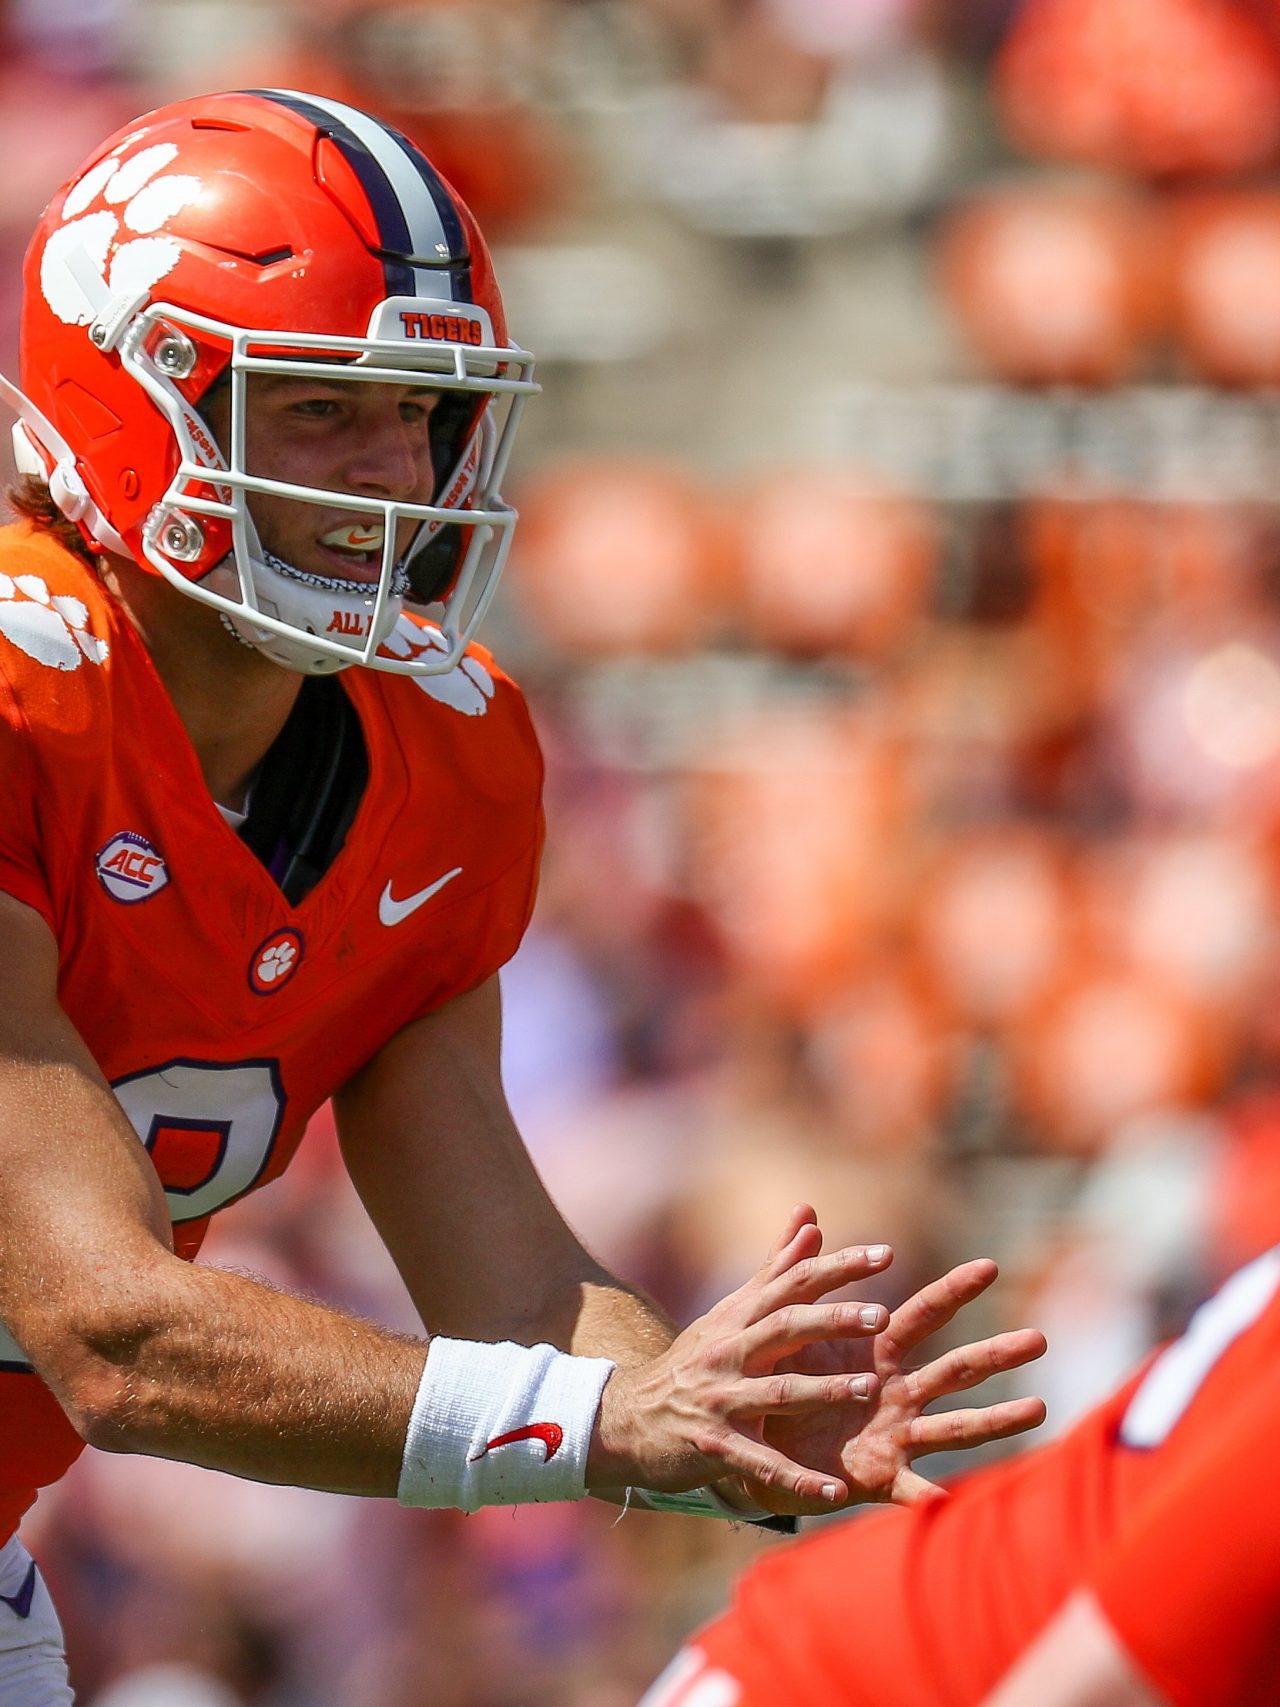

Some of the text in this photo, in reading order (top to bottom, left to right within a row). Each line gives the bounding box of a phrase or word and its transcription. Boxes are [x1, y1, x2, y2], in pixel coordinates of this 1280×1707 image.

[400, 312, 482, 346] TIGERS
[326, 610, 363, 636] ALL
[104, 848, 163, 883] ACC
